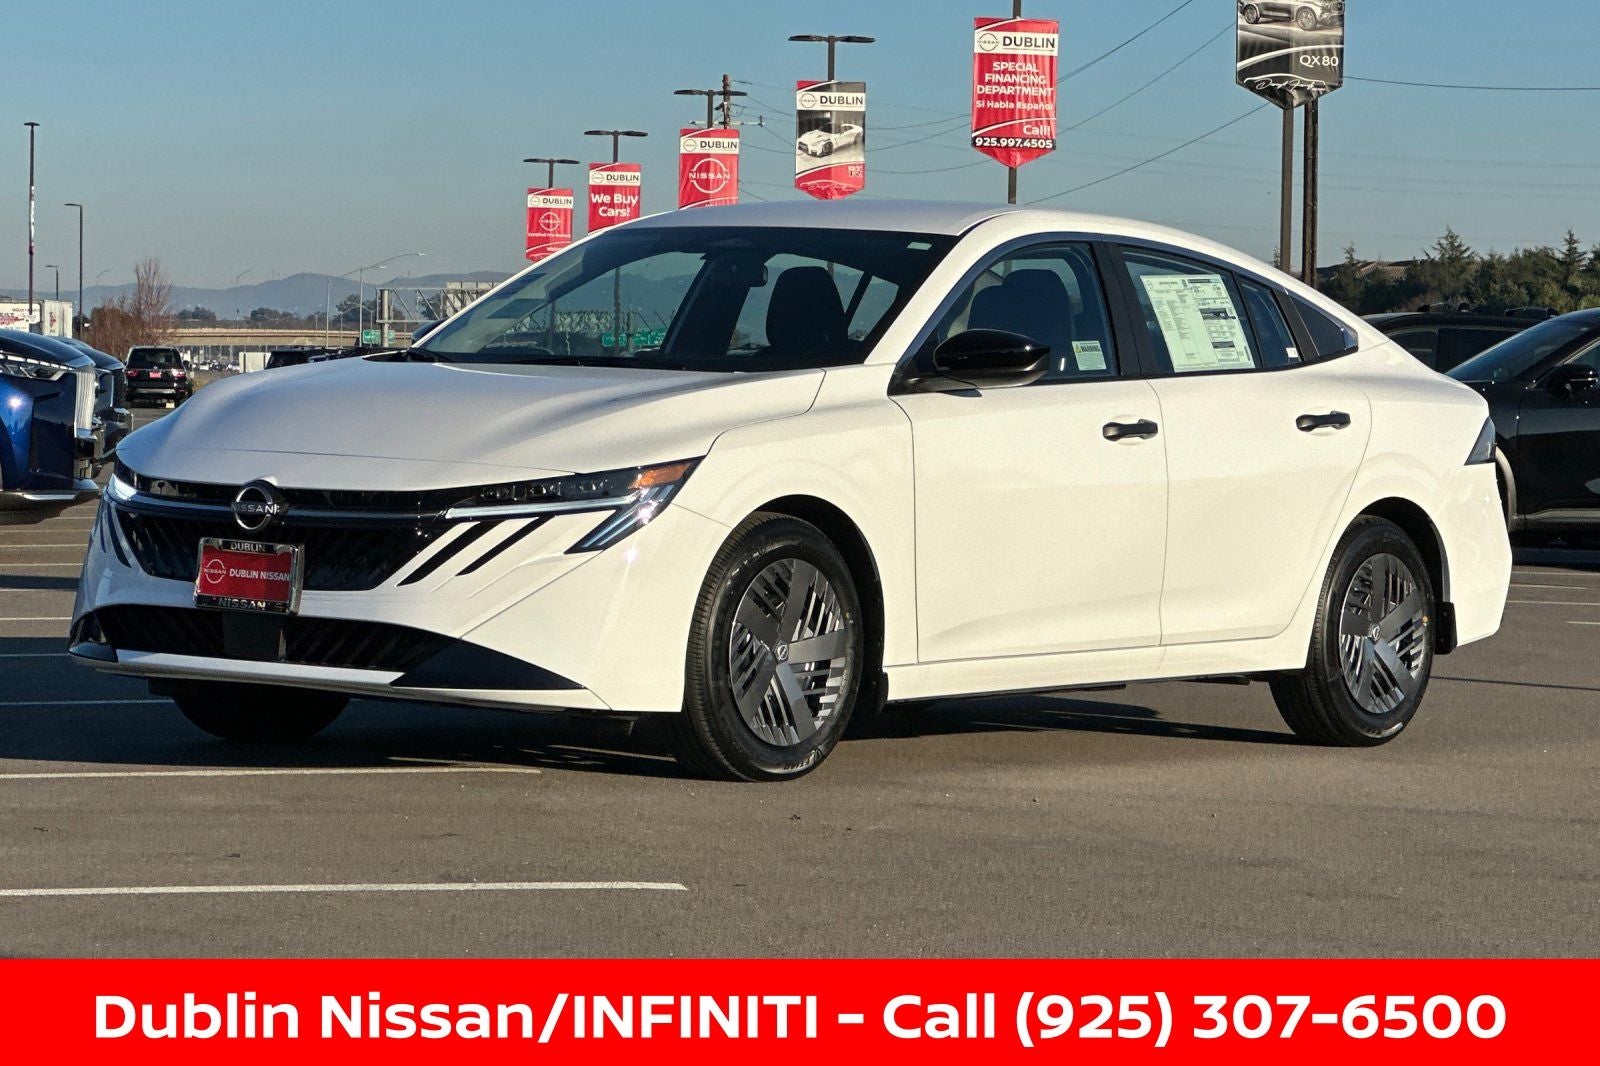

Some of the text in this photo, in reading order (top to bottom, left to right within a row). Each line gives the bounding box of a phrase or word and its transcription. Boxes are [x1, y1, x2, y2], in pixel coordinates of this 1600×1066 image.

[1002, 36, 1055, 49] DUBLIN
[992, 61, 1039, 72] SPECIAL
[1300, 54, 1339, 68] QX80
[985, 73, 1047, 85] FINANCING
[976, 85, 1054, 97] DEPARTMENT
[820, 95, 864, 106] DUBLIN
[987, 101, 1015, 109] Habla
[1016, 101, 1053, 112] Español
[1023, 124, 1051, 136] Call!
[700, 140, 738, 149] DUBLIN
[975, 137, 1053, 149] 925.997.4505
[606, 173, 640, 182] DUBLIN
[688, 172, 731, 180] NISSAN
[542, 197, 572, 206] DUBLIN
[591, 192, 639, 207] We Buy
[598, 206, 631, 218] Cars!
[231, 503, 275, 515] NISSAN
[230, 541, 266, 552] DUBLIN
[204, 567, 226, 575] NISSAN
[229, 568, 291, 581] DUBLIN NISSAN
[218, 597, 266, 610] NISSAN
